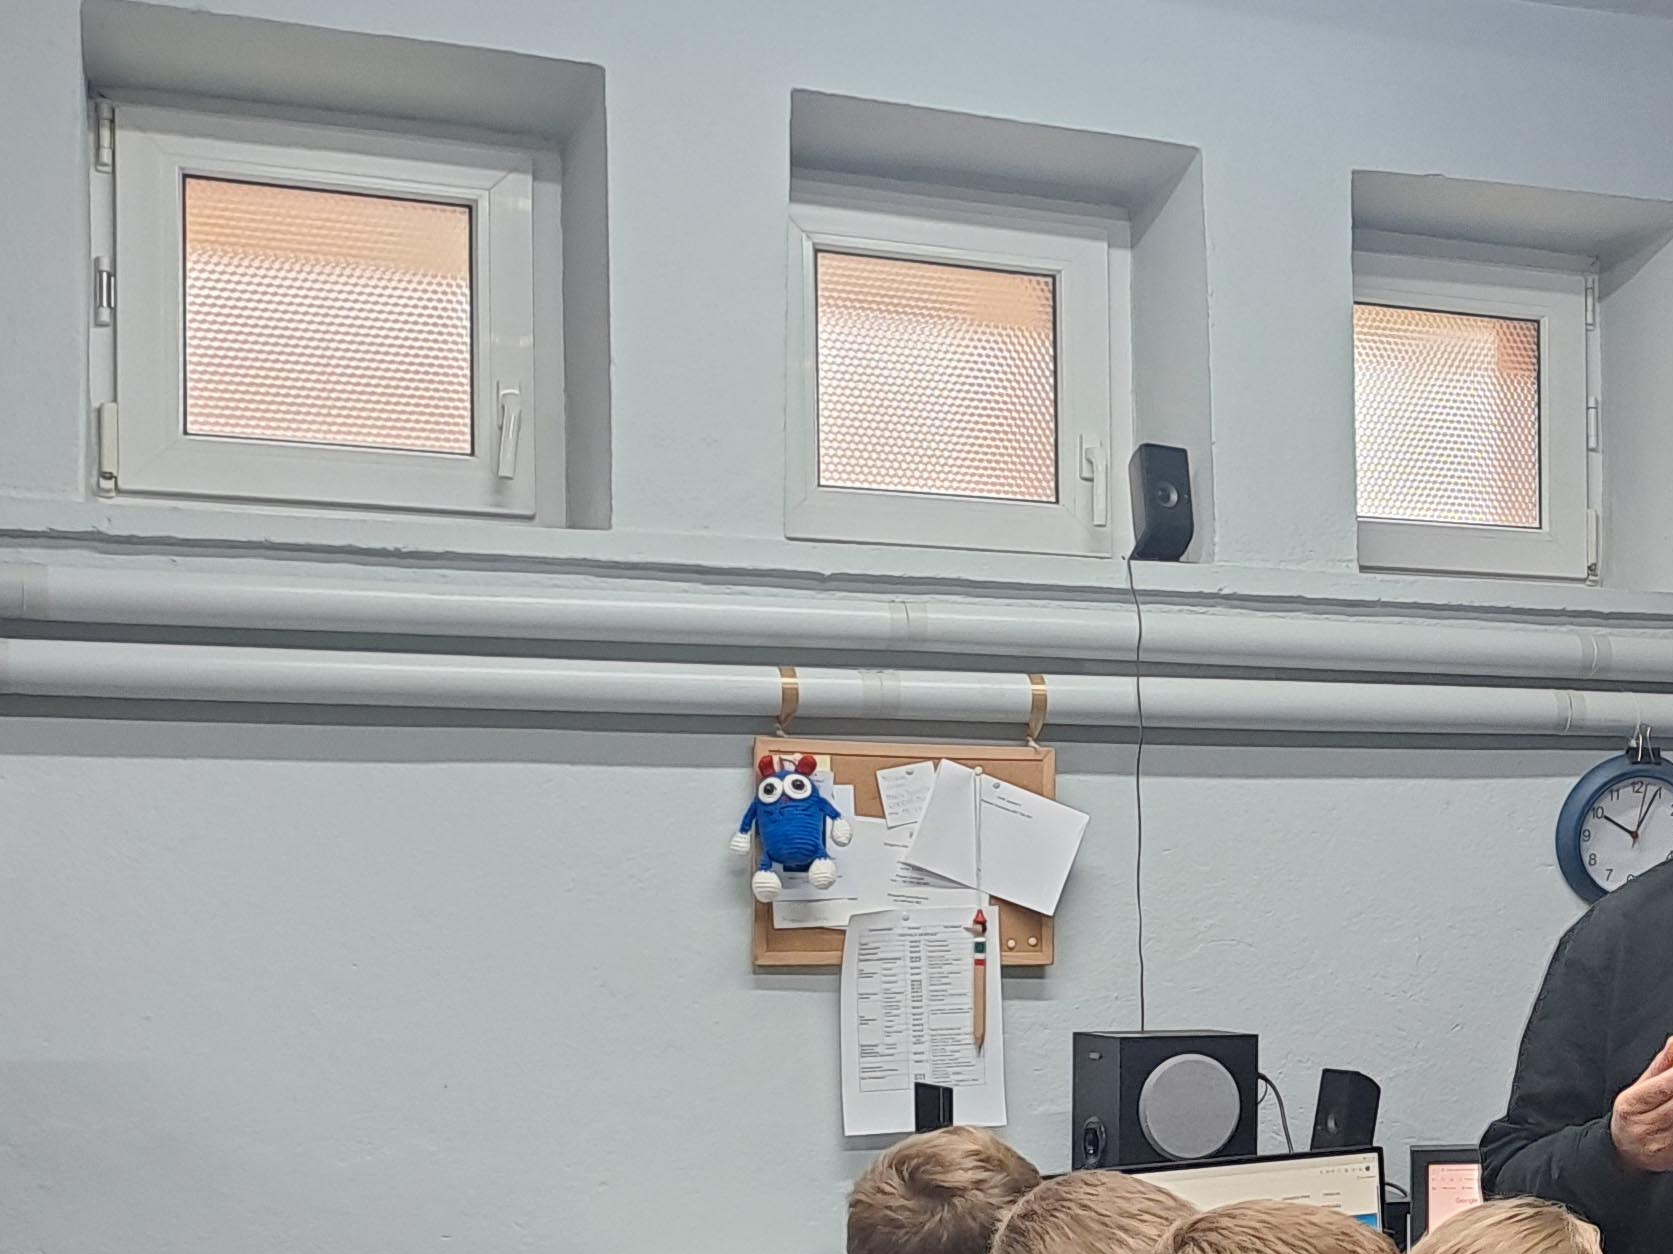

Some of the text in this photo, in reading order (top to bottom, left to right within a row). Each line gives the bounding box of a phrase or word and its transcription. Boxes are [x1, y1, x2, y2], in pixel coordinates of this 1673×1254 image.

[1631, 780, 1644, 794] 12
[1609, 789, 1620, 801] 11
[1592, 806, 1605, 820] 10
[1582, 828, 1591, 842] 9
[1588, 852, 1597, 866] 8
[1605, 868, 1613, 881] 7
